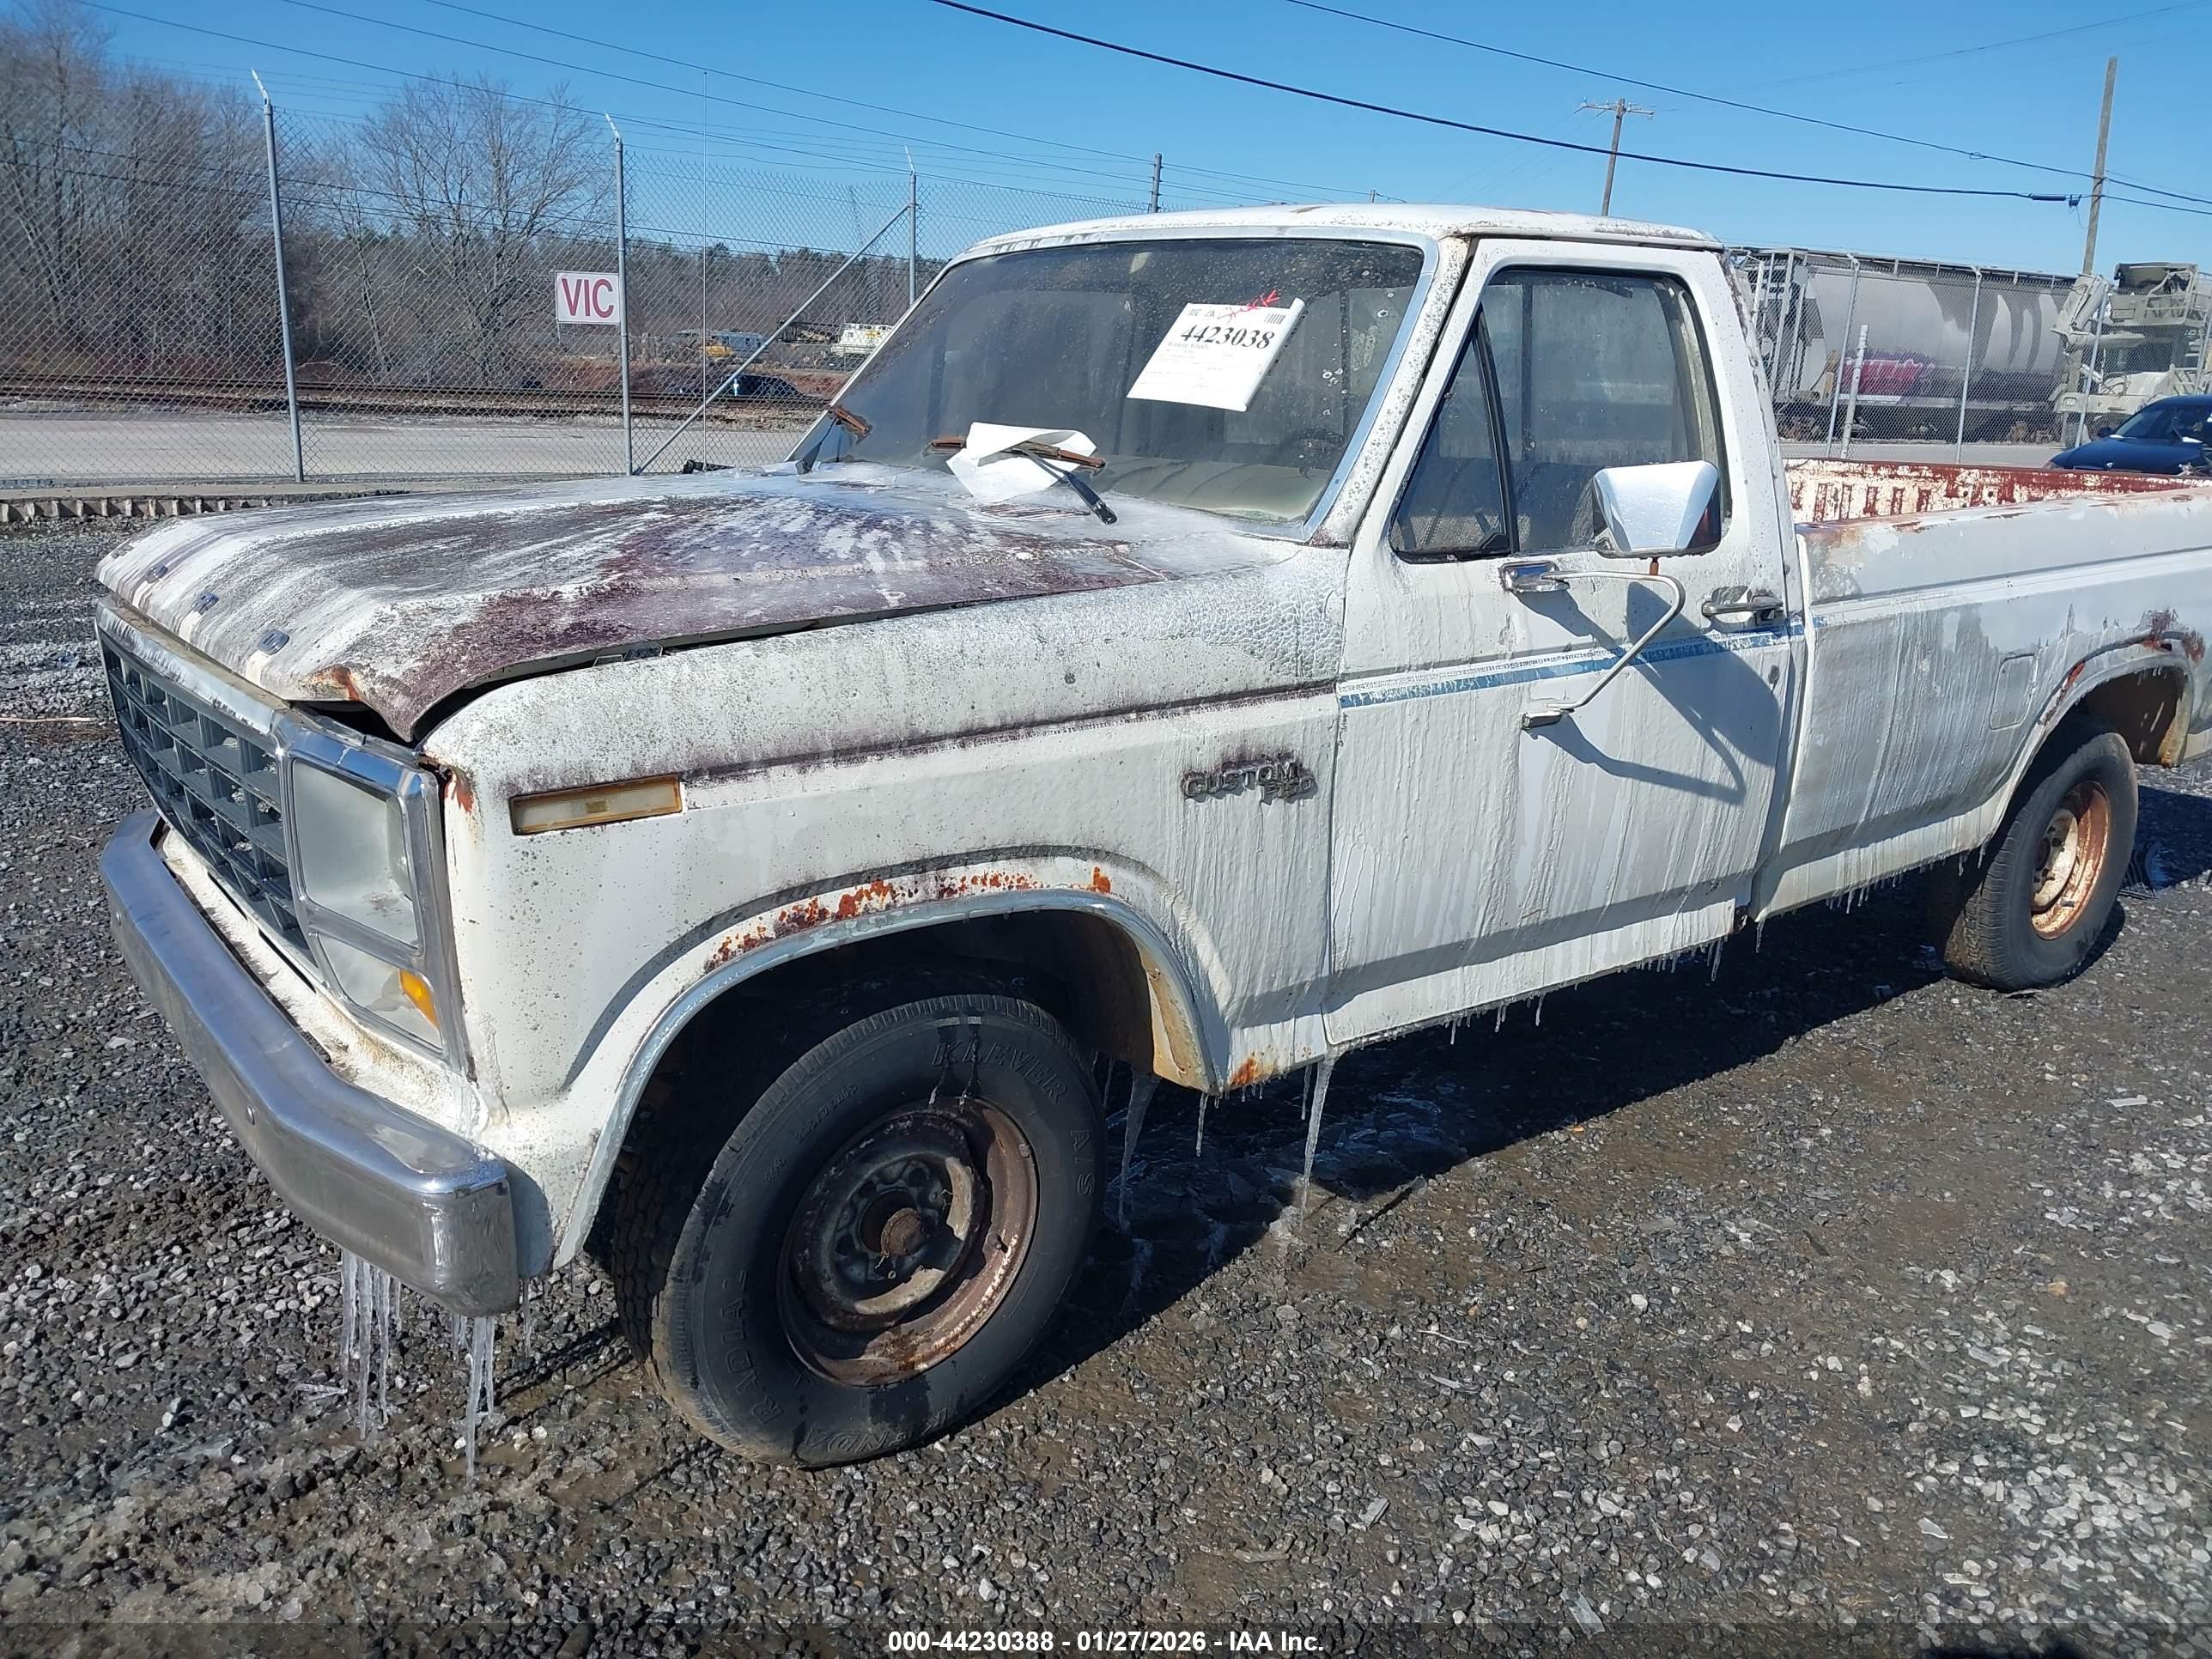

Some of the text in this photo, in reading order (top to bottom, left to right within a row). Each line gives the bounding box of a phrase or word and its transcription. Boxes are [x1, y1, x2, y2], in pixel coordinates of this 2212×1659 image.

[561, 277, 615, 319] VIC
[1180, 324, 1276, 350] 4423038
[1182, 759, 1299, 797] CUSTOM
[931, 1040, 1069, 1105] KLEVER
[718, 1269, 784, 1425] RADIAL
